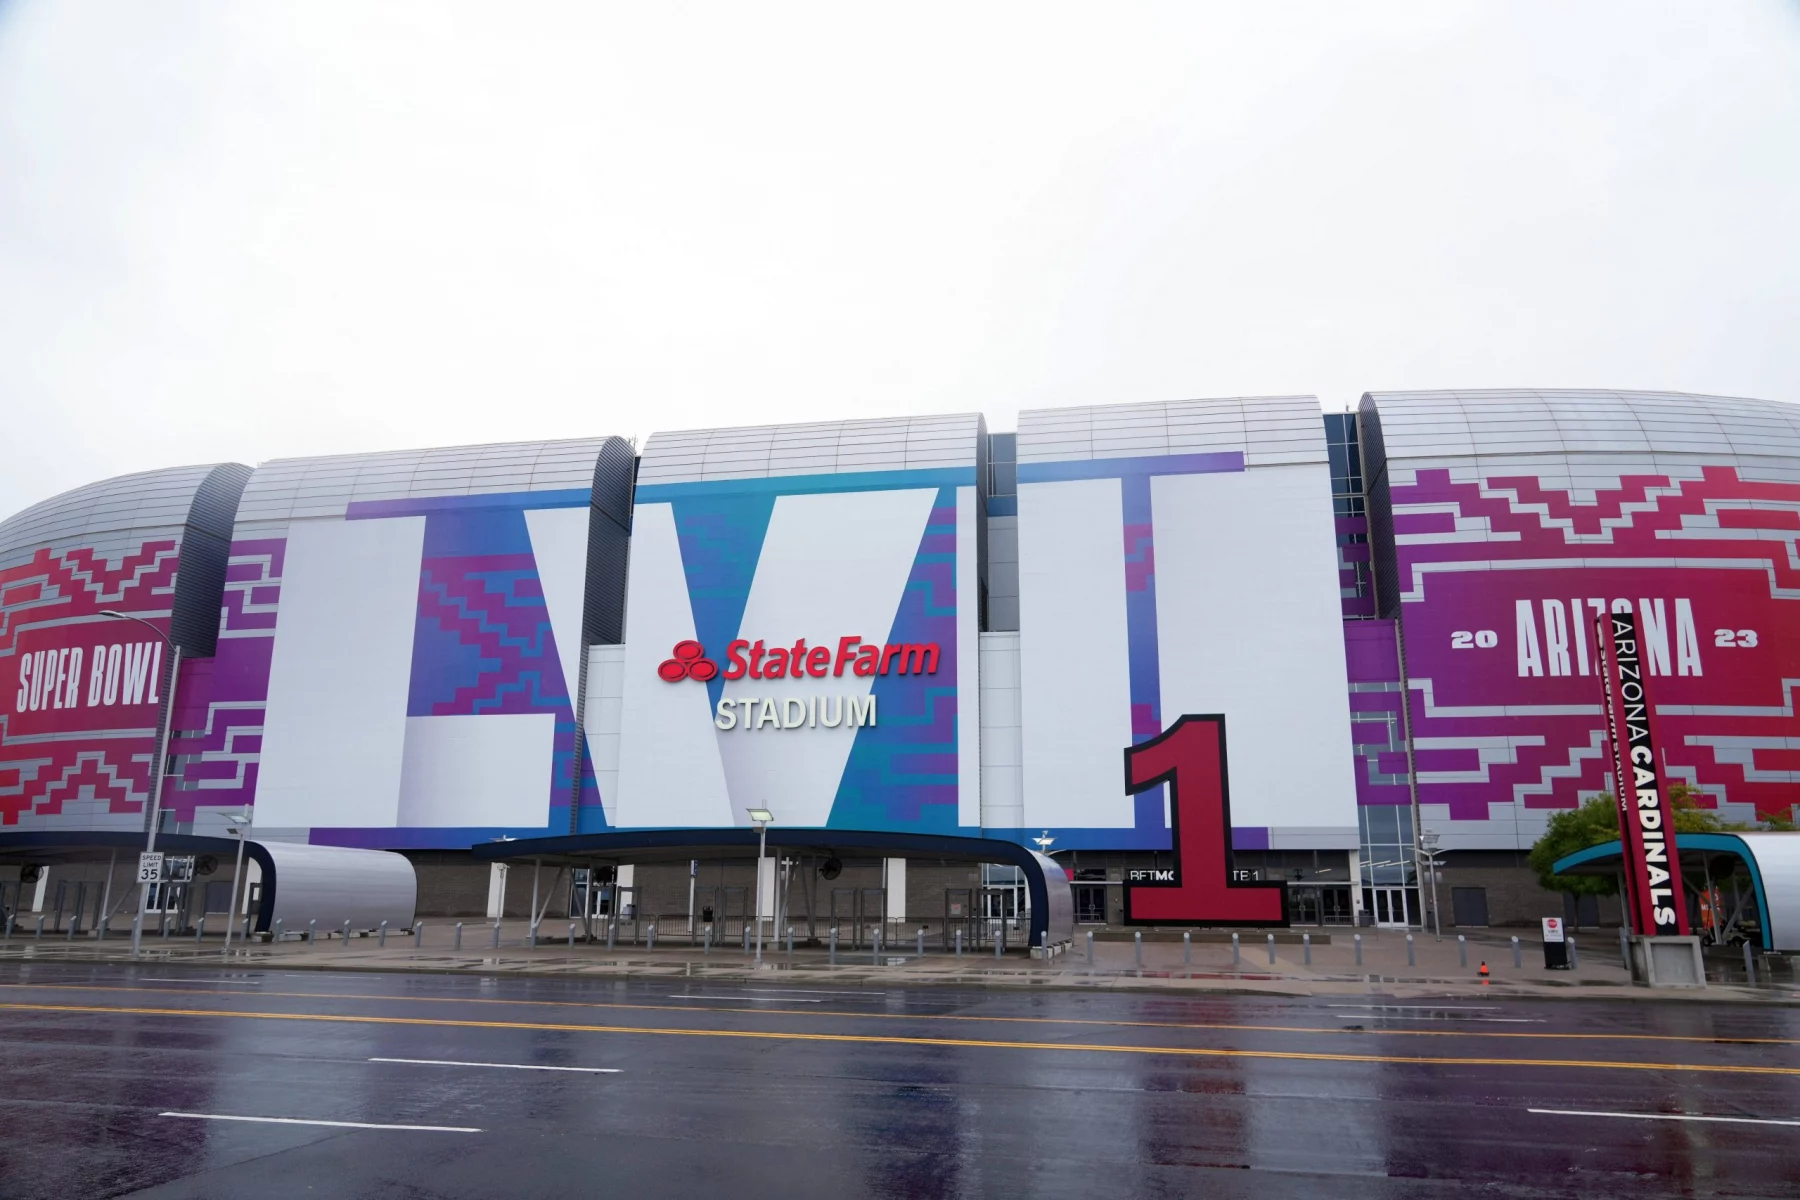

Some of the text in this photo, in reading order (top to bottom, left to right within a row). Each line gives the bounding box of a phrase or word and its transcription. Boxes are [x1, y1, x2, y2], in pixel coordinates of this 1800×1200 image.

[1451, 598, 1759, 677] 20 ARINA 23
[16, 641, 162, 712] SUPER BOWL
[715, 694, 876, 730] STADIUM
[1611, 619, 1677, 925] ARIZONA CARDINALS
[1123, 713, 1290, 927] 1
[141, 868, 158, 880] 35
